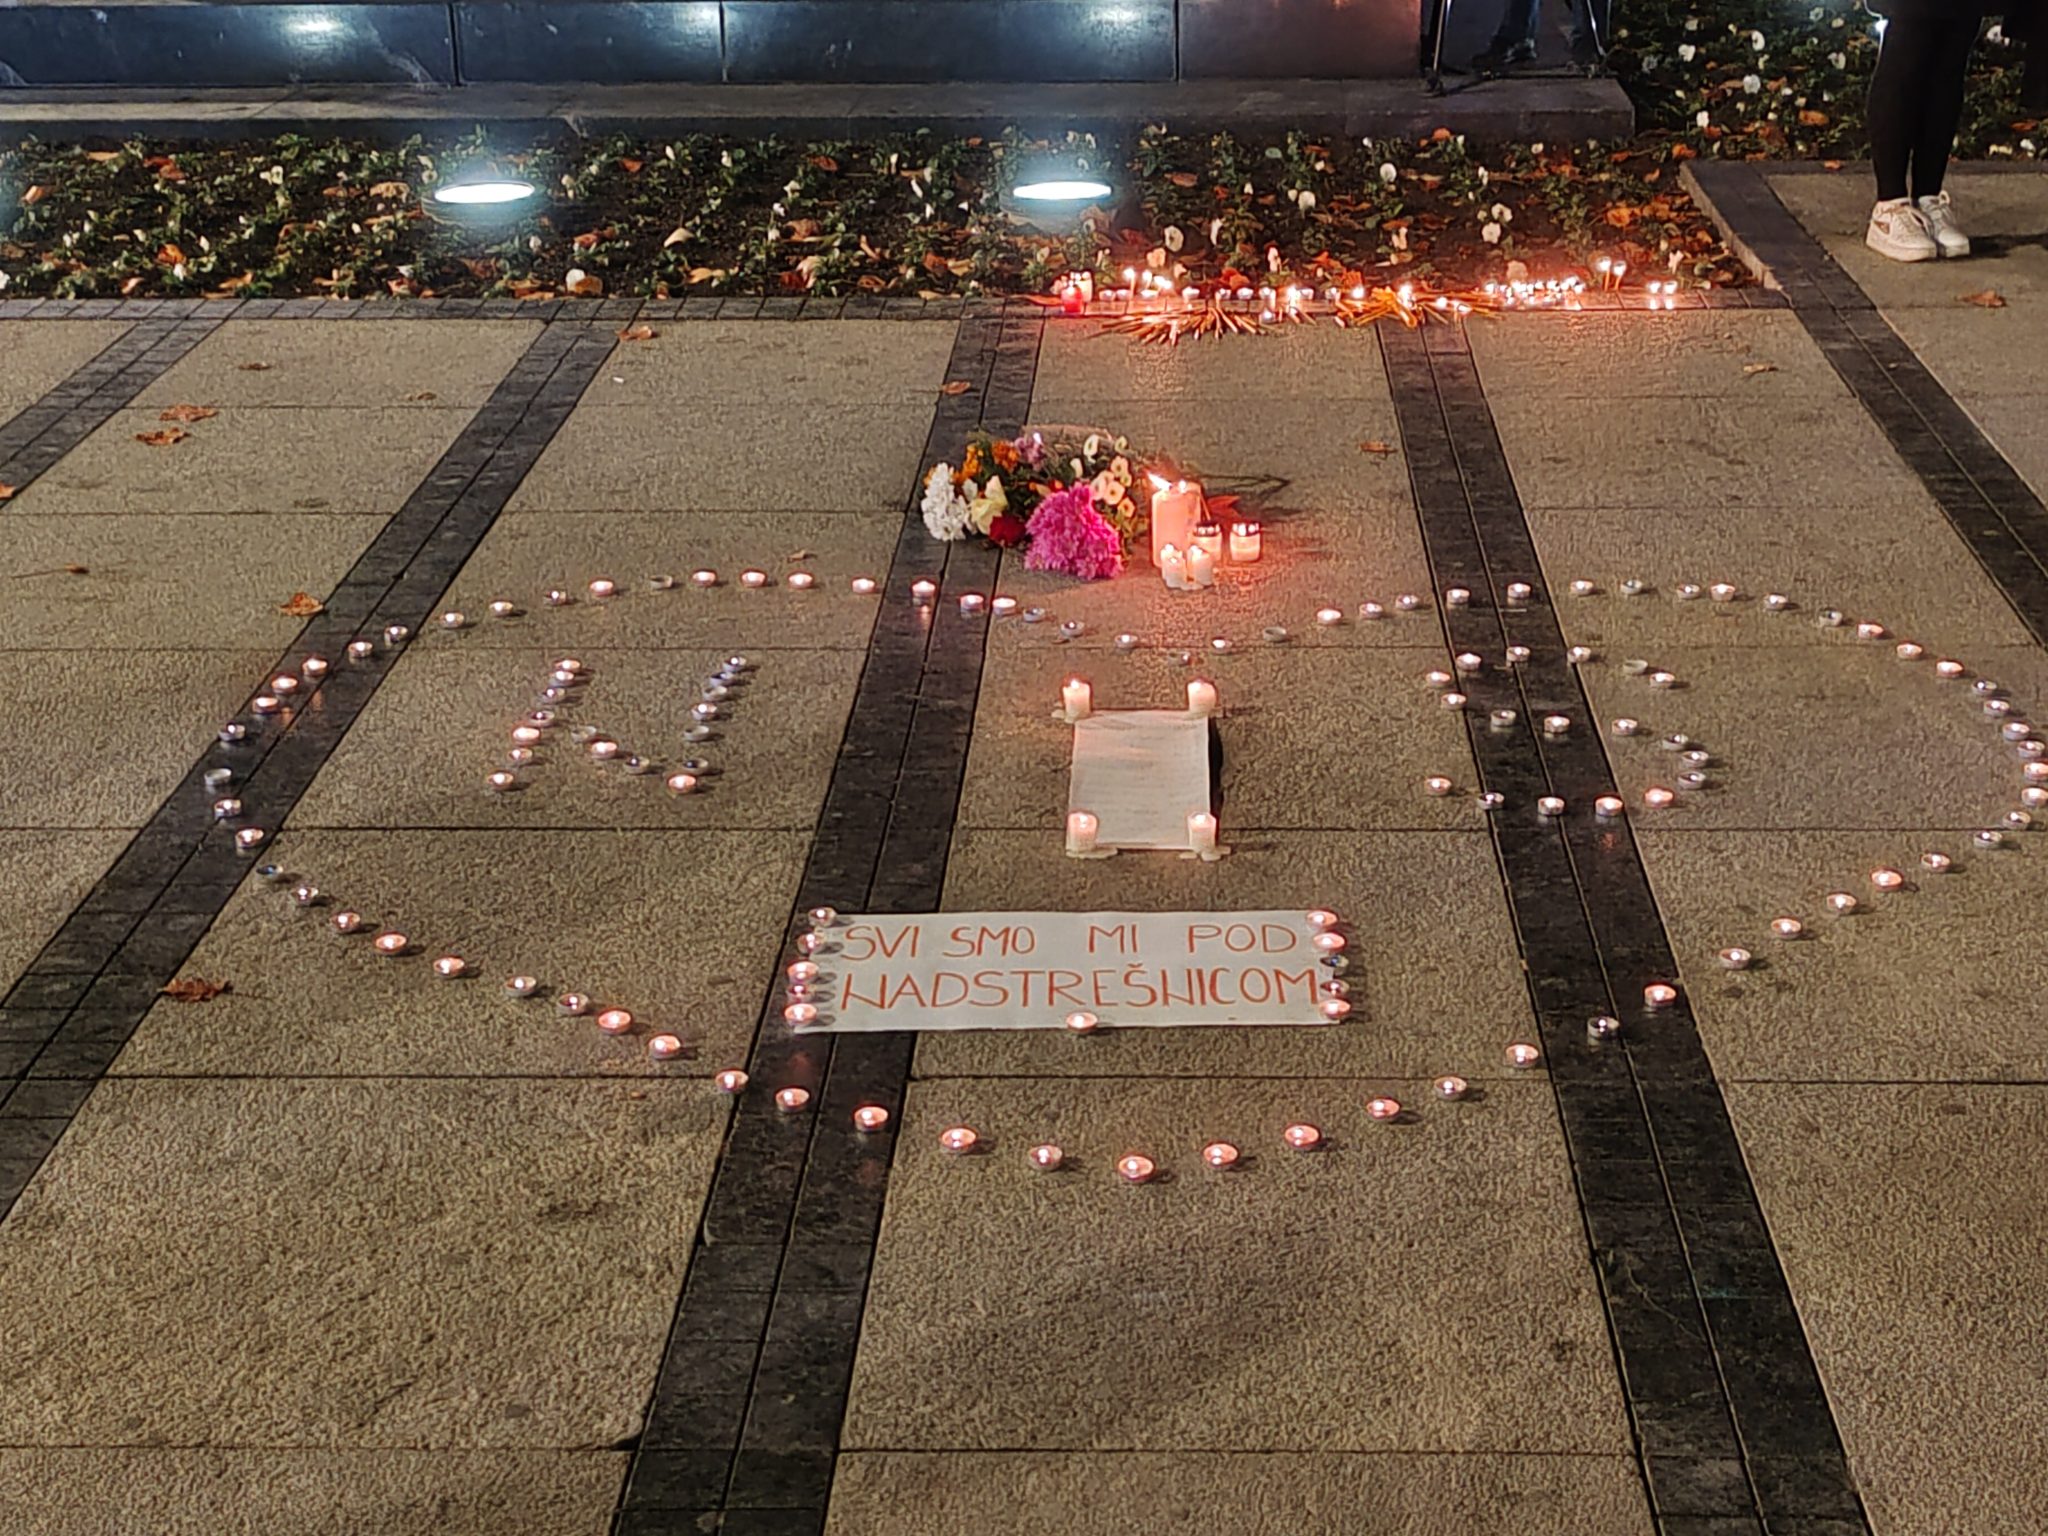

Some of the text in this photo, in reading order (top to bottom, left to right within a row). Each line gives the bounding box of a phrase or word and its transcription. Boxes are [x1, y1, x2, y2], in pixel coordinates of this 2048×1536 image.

[840, 923, 1297, 961] SVI SMO MI POD
[840, 962, 1319, 1011] NADSTREŠNICOM
